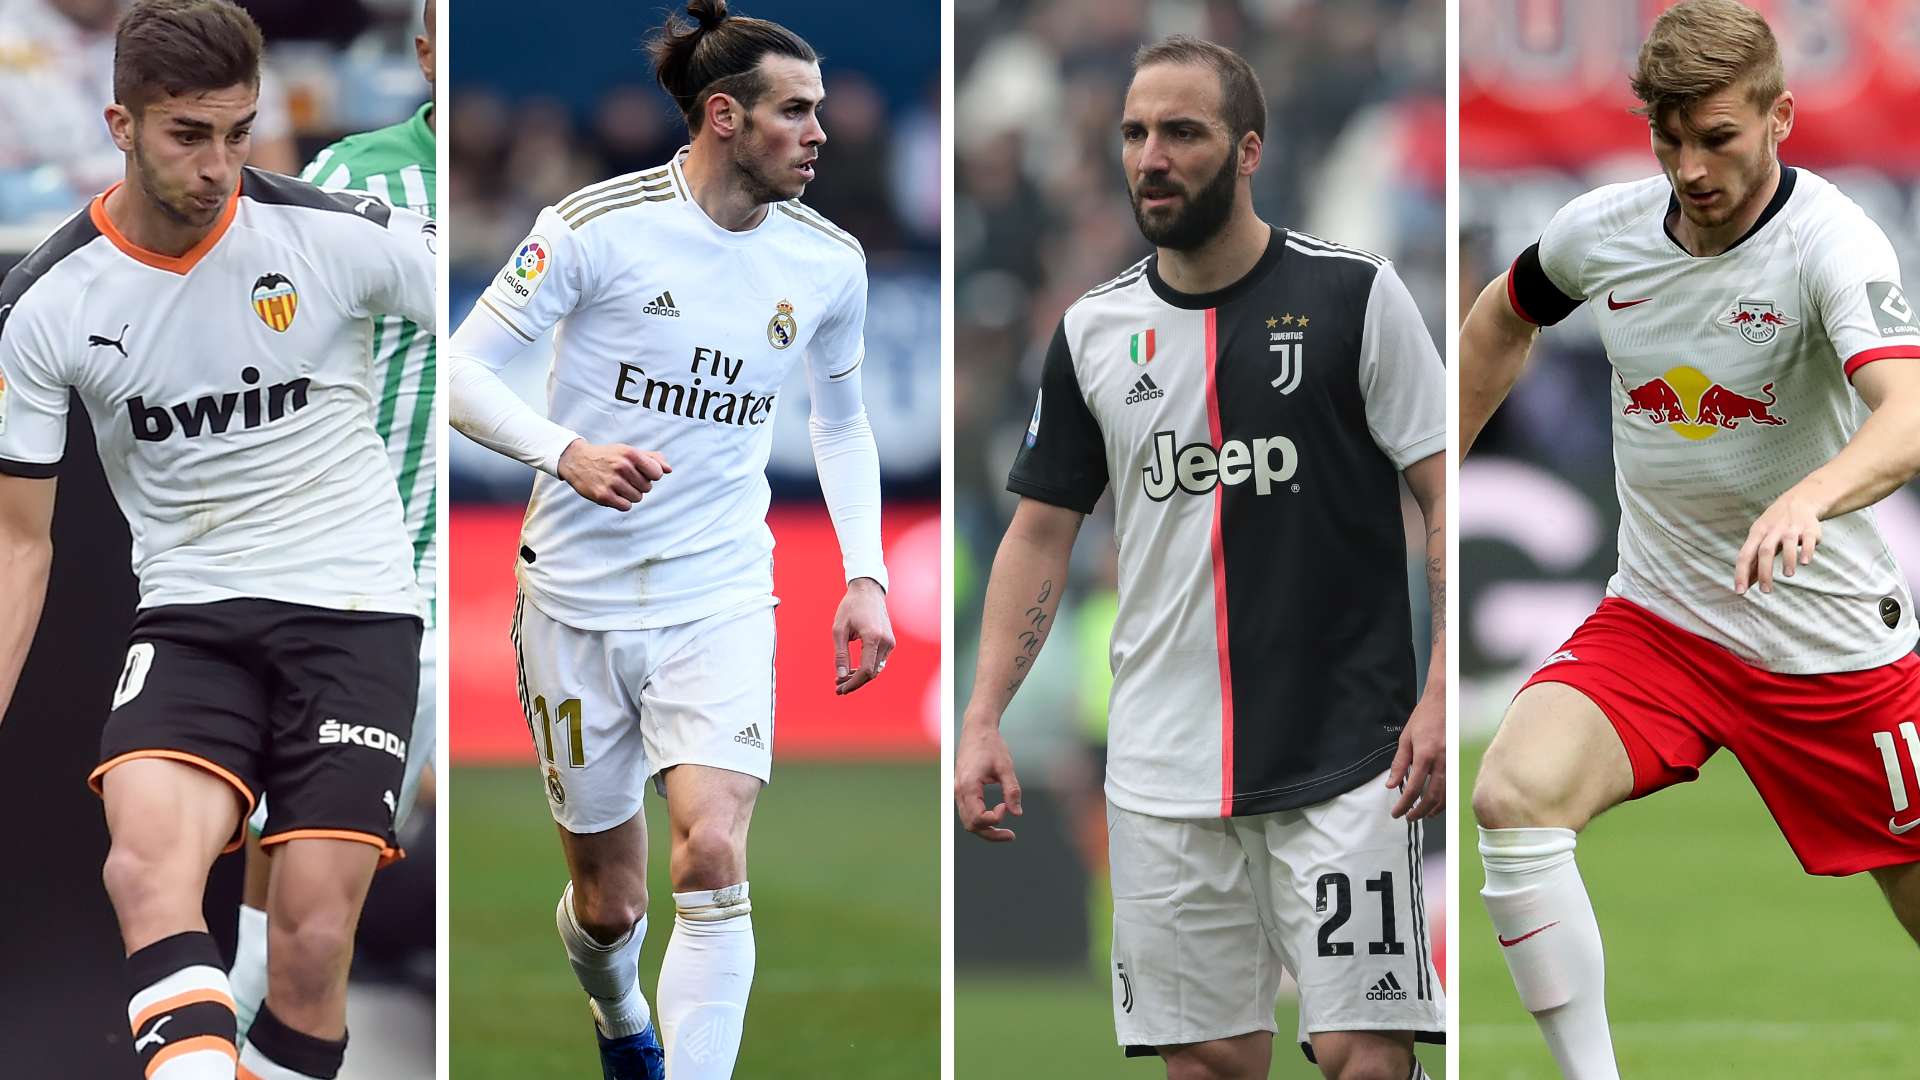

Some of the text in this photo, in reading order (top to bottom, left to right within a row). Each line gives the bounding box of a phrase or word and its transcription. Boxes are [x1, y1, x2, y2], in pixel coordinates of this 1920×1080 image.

[504, 271, 529, 297] LaLiga
[643, 306, 680, 317] adidas
[691, 346, 744, 386] Fly
[1270, 331, 1304, 341] JUVENTUS
[126, 366, 312, 442] bwin
[614, 361, 775, 426] Emirates
[1125, 389, 1164, 405] adidas
[1142, 430, 1299, 502] Jeep
[111, 642, 156, 712] 0
[534, 694, 585, 769] 11
[1872, 721, 1920, 813] 11
[1315, 870, 1405, 957] 21
[1365, 988, 1408, 1001] adidas
